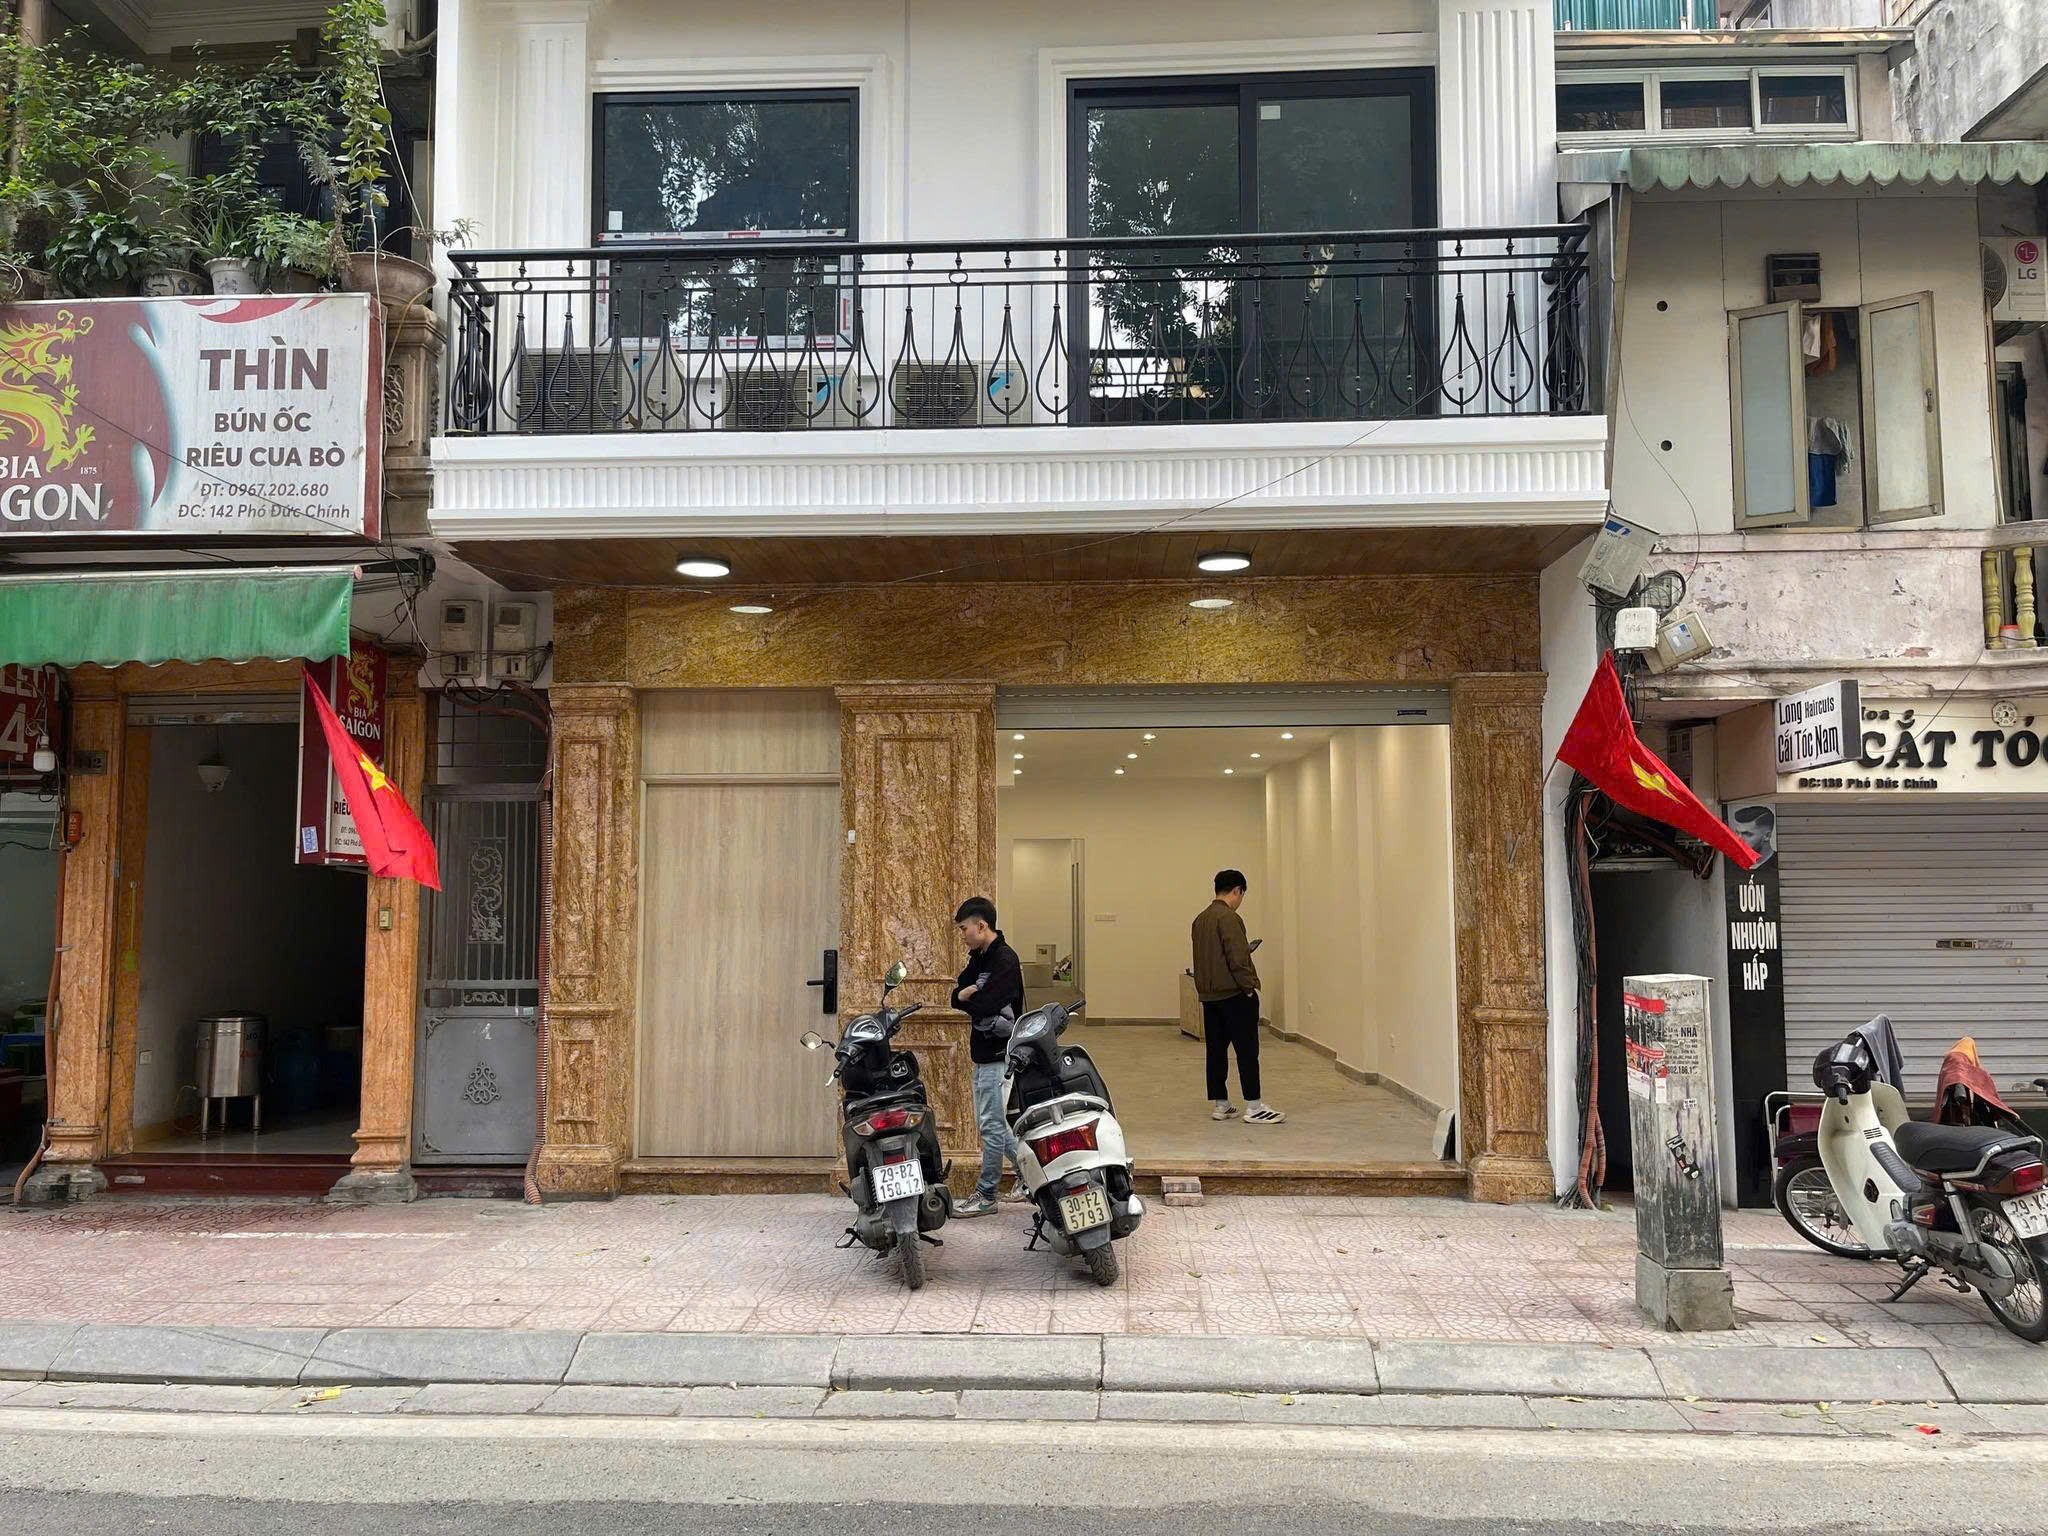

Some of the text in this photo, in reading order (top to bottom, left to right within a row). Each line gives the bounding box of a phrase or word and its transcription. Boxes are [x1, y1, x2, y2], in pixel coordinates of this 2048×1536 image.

[2018, 268, 2037, 280] LG
[200, 336, 328, 391] THÌN
[214, 405, 312, 433] BÚN ỐC
[186, 441, 345, 467] RIÊU CUA BÒ
[0, 456, 42, 479] BIA
[80, 466, 97, 475] 1875
[0, 483, 102, 521] GON
[200, 483, 329, 497] ĐT: 0967.202.680
[178, 503, 350, 518] ĐC: 142 Phó Đức Chính
[354, 707, 367, 720] BIA
[1779, 696, 1835, 726] Long Haircuts
[339, 714, 381, 740] SAIGON
[1858, 709, 2048, 769] CẮT TÓ
[1778, 724, 1840, 763] Cắt Tóc Nam
[1847, 777, 1871, 788] Phó
[1874, 777, 1899, 789] Đức
[1904, 776, 1938, 789] Chính
[1739, 874, 1765, 912] UỐN
[1731, 916, 1778, 953] NHUỘM
[1743, 953, 1768, 990] HẤP
[880, 1163, 914, 1184] 29-B2
[1070, 1207, 1104, 1230] 5793
